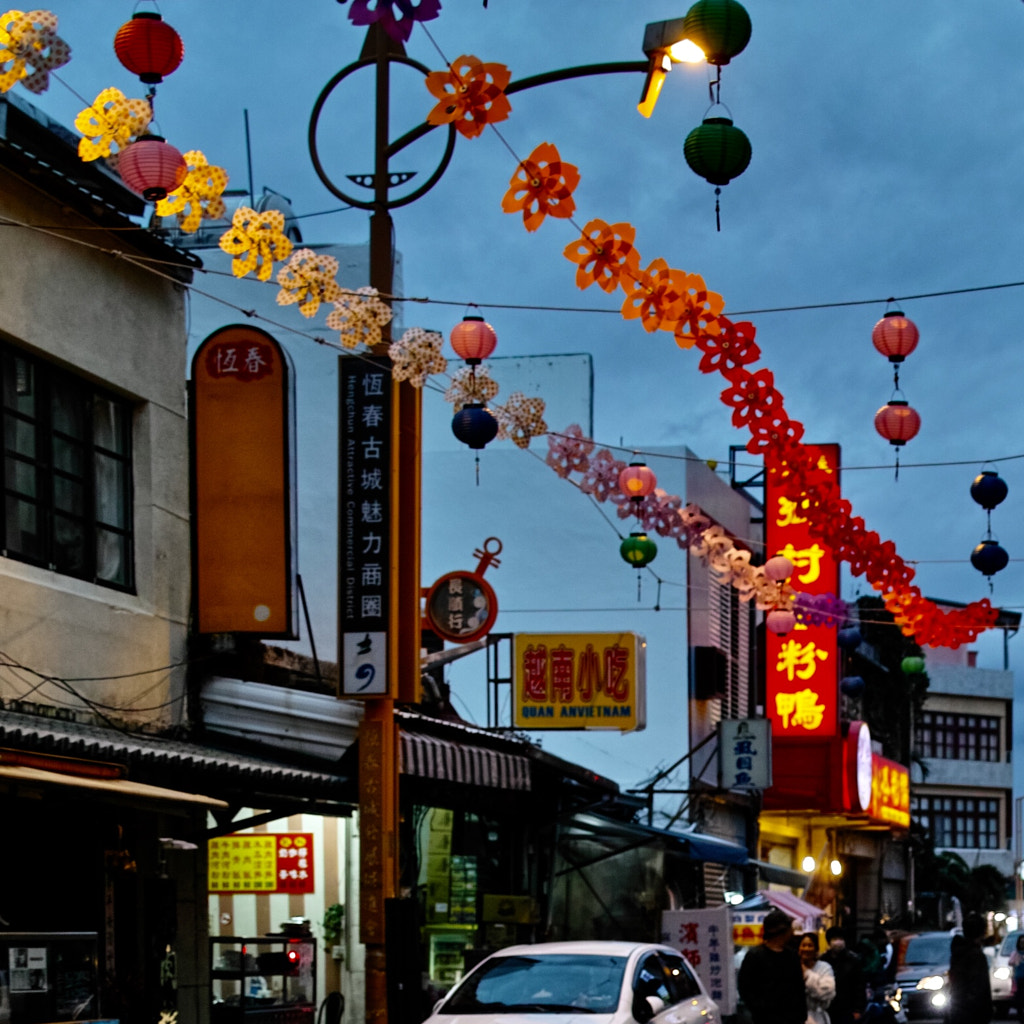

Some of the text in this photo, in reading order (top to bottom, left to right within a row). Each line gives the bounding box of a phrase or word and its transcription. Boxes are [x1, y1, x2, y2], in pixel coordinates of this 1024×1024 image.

[215, 346, 266, 374] 恆春
[346, 375, 357, 620] Hengchun Attractive Commercial District
[361, 373, 384, 619] 恆春古城魅力商圈
[522, 644, 630, 704] 越南小吃
[521, 706, 554, 718] QUAN
